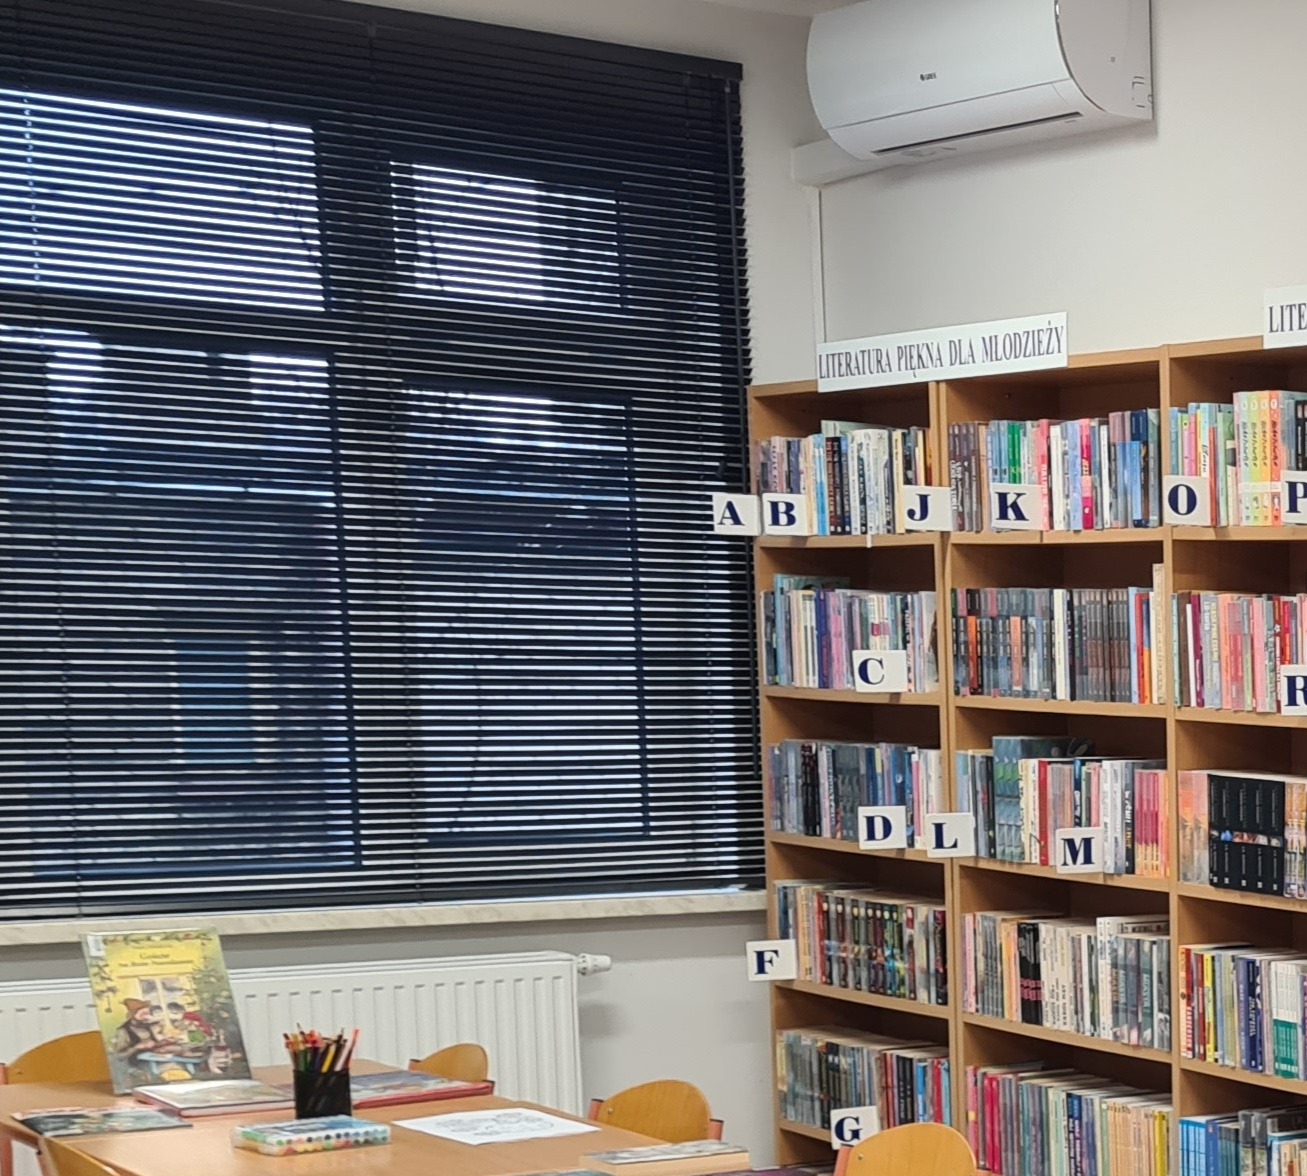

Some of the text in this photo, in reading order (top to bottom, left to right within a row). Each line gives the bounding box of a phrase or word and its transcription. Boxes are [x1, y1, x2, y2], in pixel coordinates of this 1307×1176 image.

[818, 341, 893, 379] LITERATURA
[896, 340, 945, 378] PIĘKNA
[948, 338, 976, 367] DLA
[717, 500, 744, 526] A
[768, 500, 797, 527] B
[906, 493, 930, 522] J
[995, 491, 1029, 522] K
[1167, 483, 1198, 516] O
[857, 657, 884, 685] C
[864, 815, 893, 842] D
[932, 822, 958, 850] L
[1061, 836, 1095, 867] M
[753, 949, 780, 976] F
[834, 1116, 862, 1143] G
